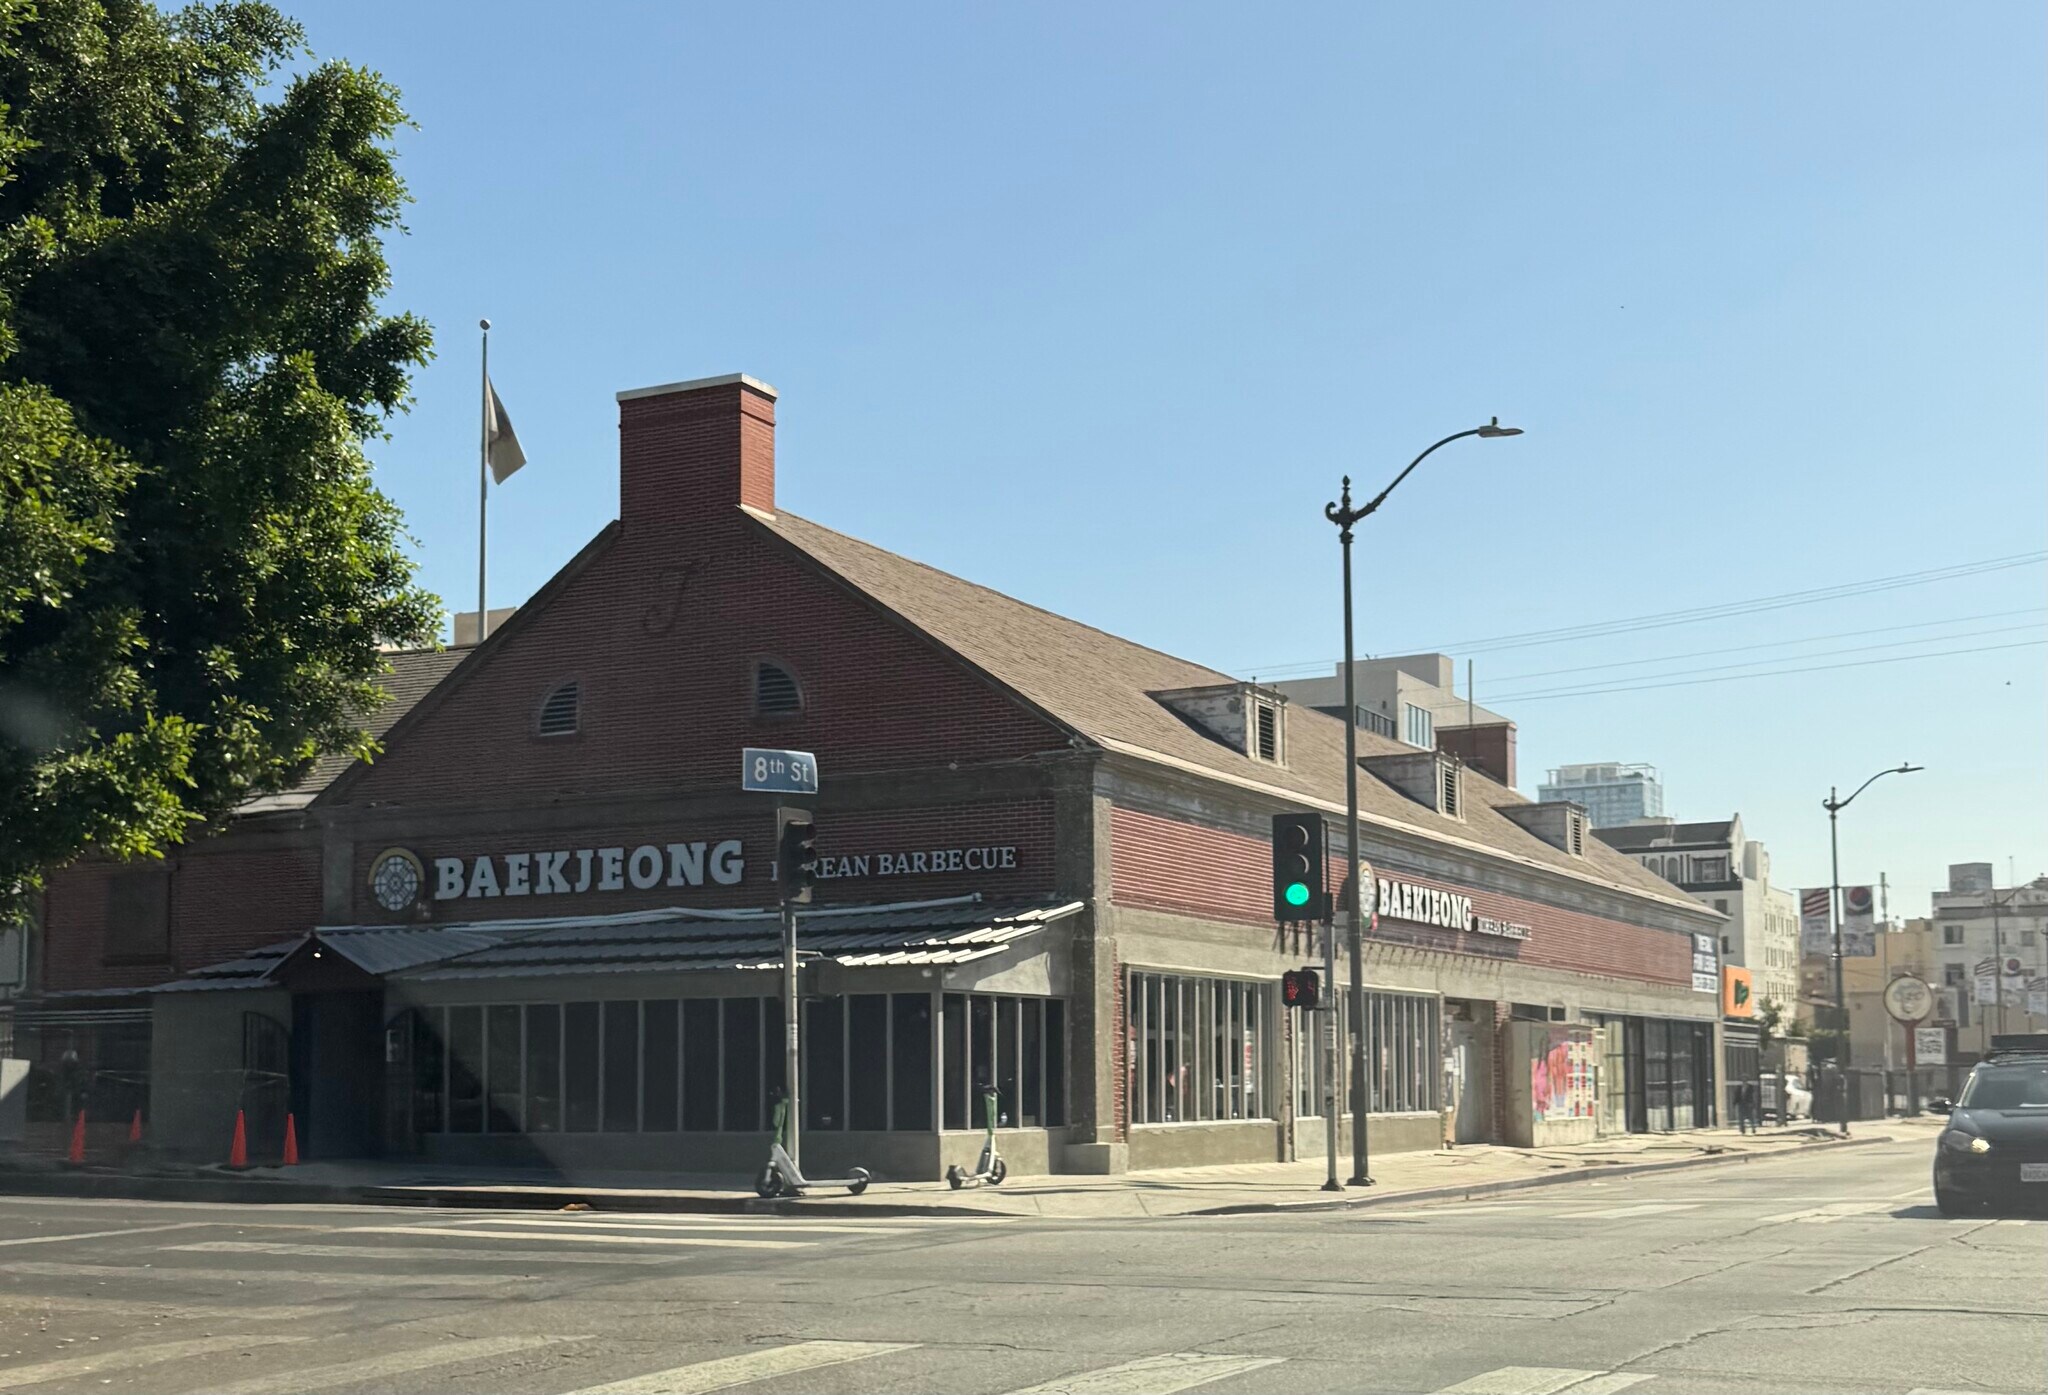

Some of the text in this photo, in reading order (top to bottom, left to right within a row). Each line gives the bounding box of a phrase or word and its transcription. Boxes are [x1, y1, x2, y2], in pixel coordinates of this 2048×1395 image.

[754, 756, 809, 783] 8th St
[434, 840, 744, 900] BAEKJEONG
[877, 846, 1017, 876] BARBECUE
[1378, 878, 1473, 932] BAEKJEONG
